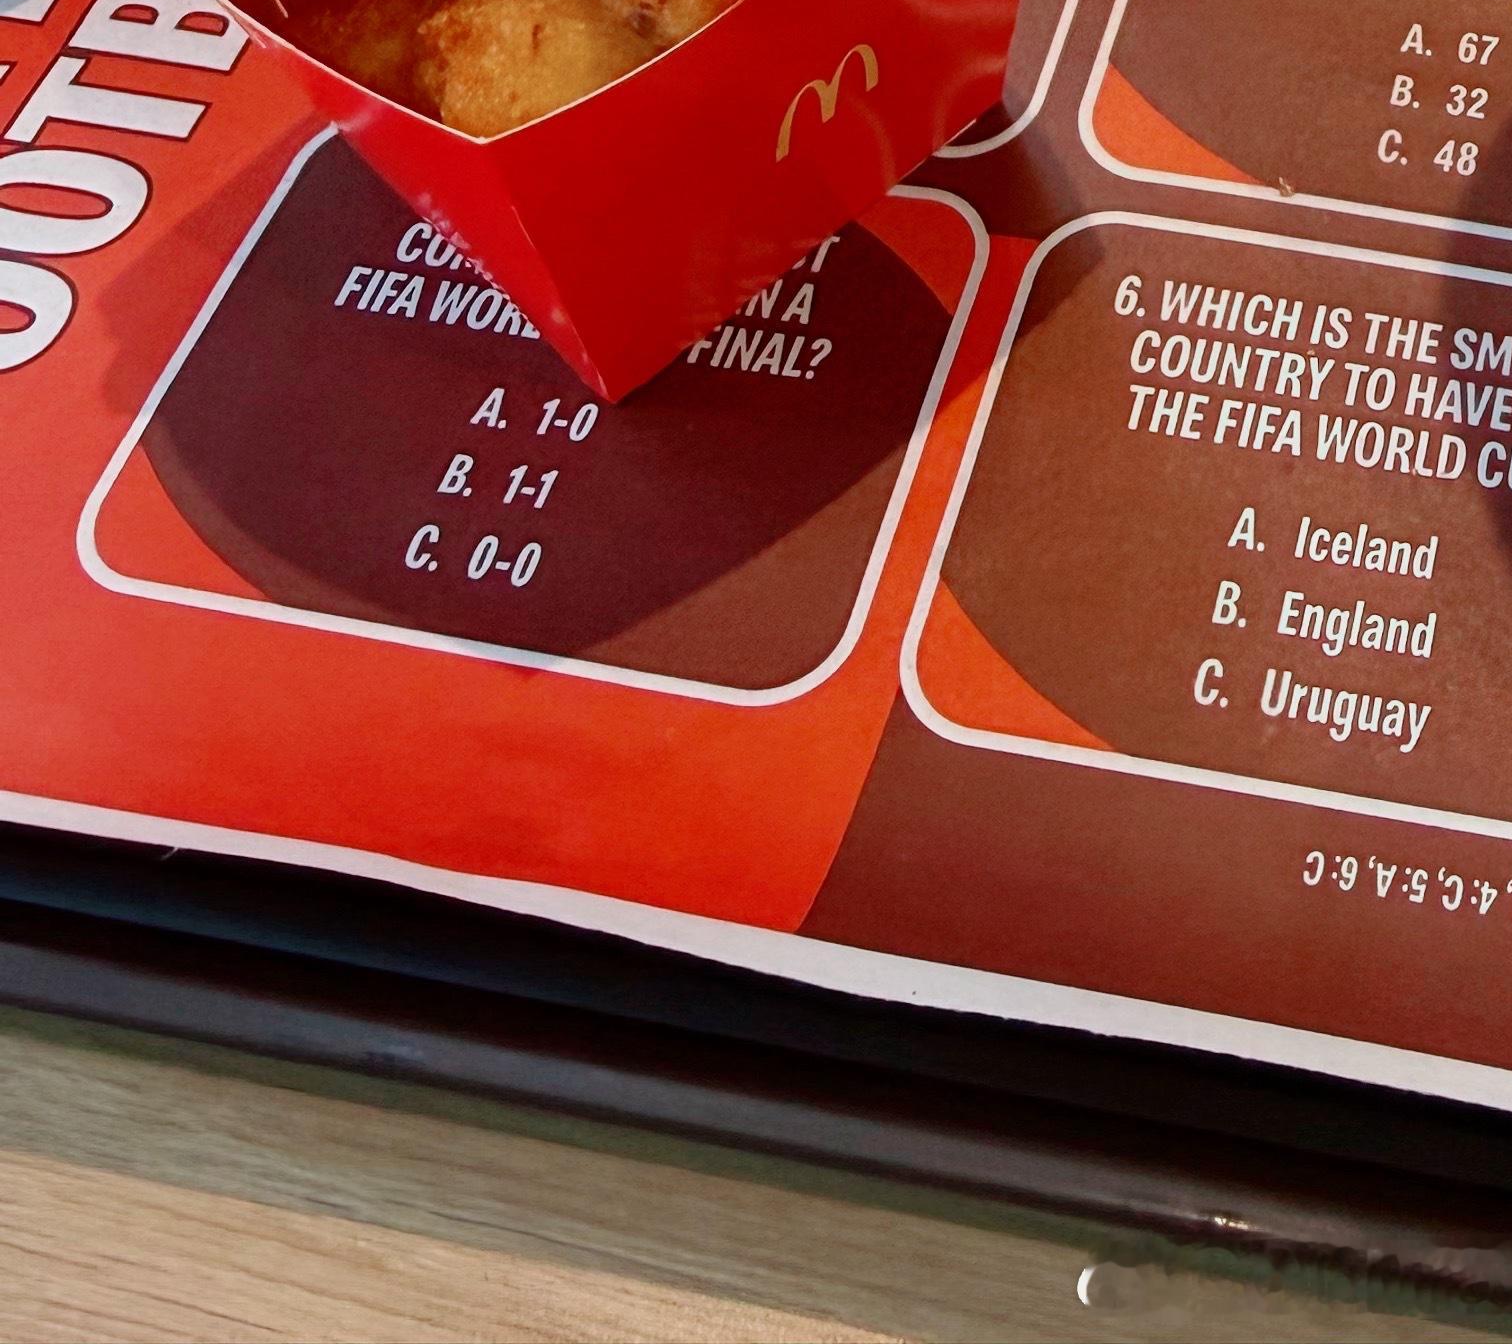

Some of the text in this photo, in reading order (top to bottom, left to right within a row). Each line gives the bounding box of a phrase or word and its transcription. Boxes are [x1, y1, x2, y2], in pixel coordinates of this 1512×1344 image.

[1400, 23, 1500, 66] A. 67
[1389, 75, 1488, 119] B. 32
[1377, 128, 1479, 175] C. 48
[334, 265, 833, 380] FIFA WOR FINAL?
[780, 282, 815, 325] A
[1114, 274, 1146, 319] 6.
[1163, 280, 1301, 342] WHICH
[1311, 304, 1353, 351] IS
[1363, 313, 1442, 366] THE
[1130, 329, 1335, 401] COUNTRY
[1342, 360, 1396, 412] TO
[470, 387, 599, 443] A. 1-0
[1127, 385, 1206, 442] THE
[1213, 399, 1303, 456] FIFA
[1316, 412, 1467, 482] WORLD
[437, 453, 560, 510] B. 1-1
[405, 523, 543, 588] C. 0-0
[1228, 507, 1438, 581] A. Iceland
[1211, 580, 1436, 660] B. England
[1193, 657, 1431, 754] C. Uruguay
